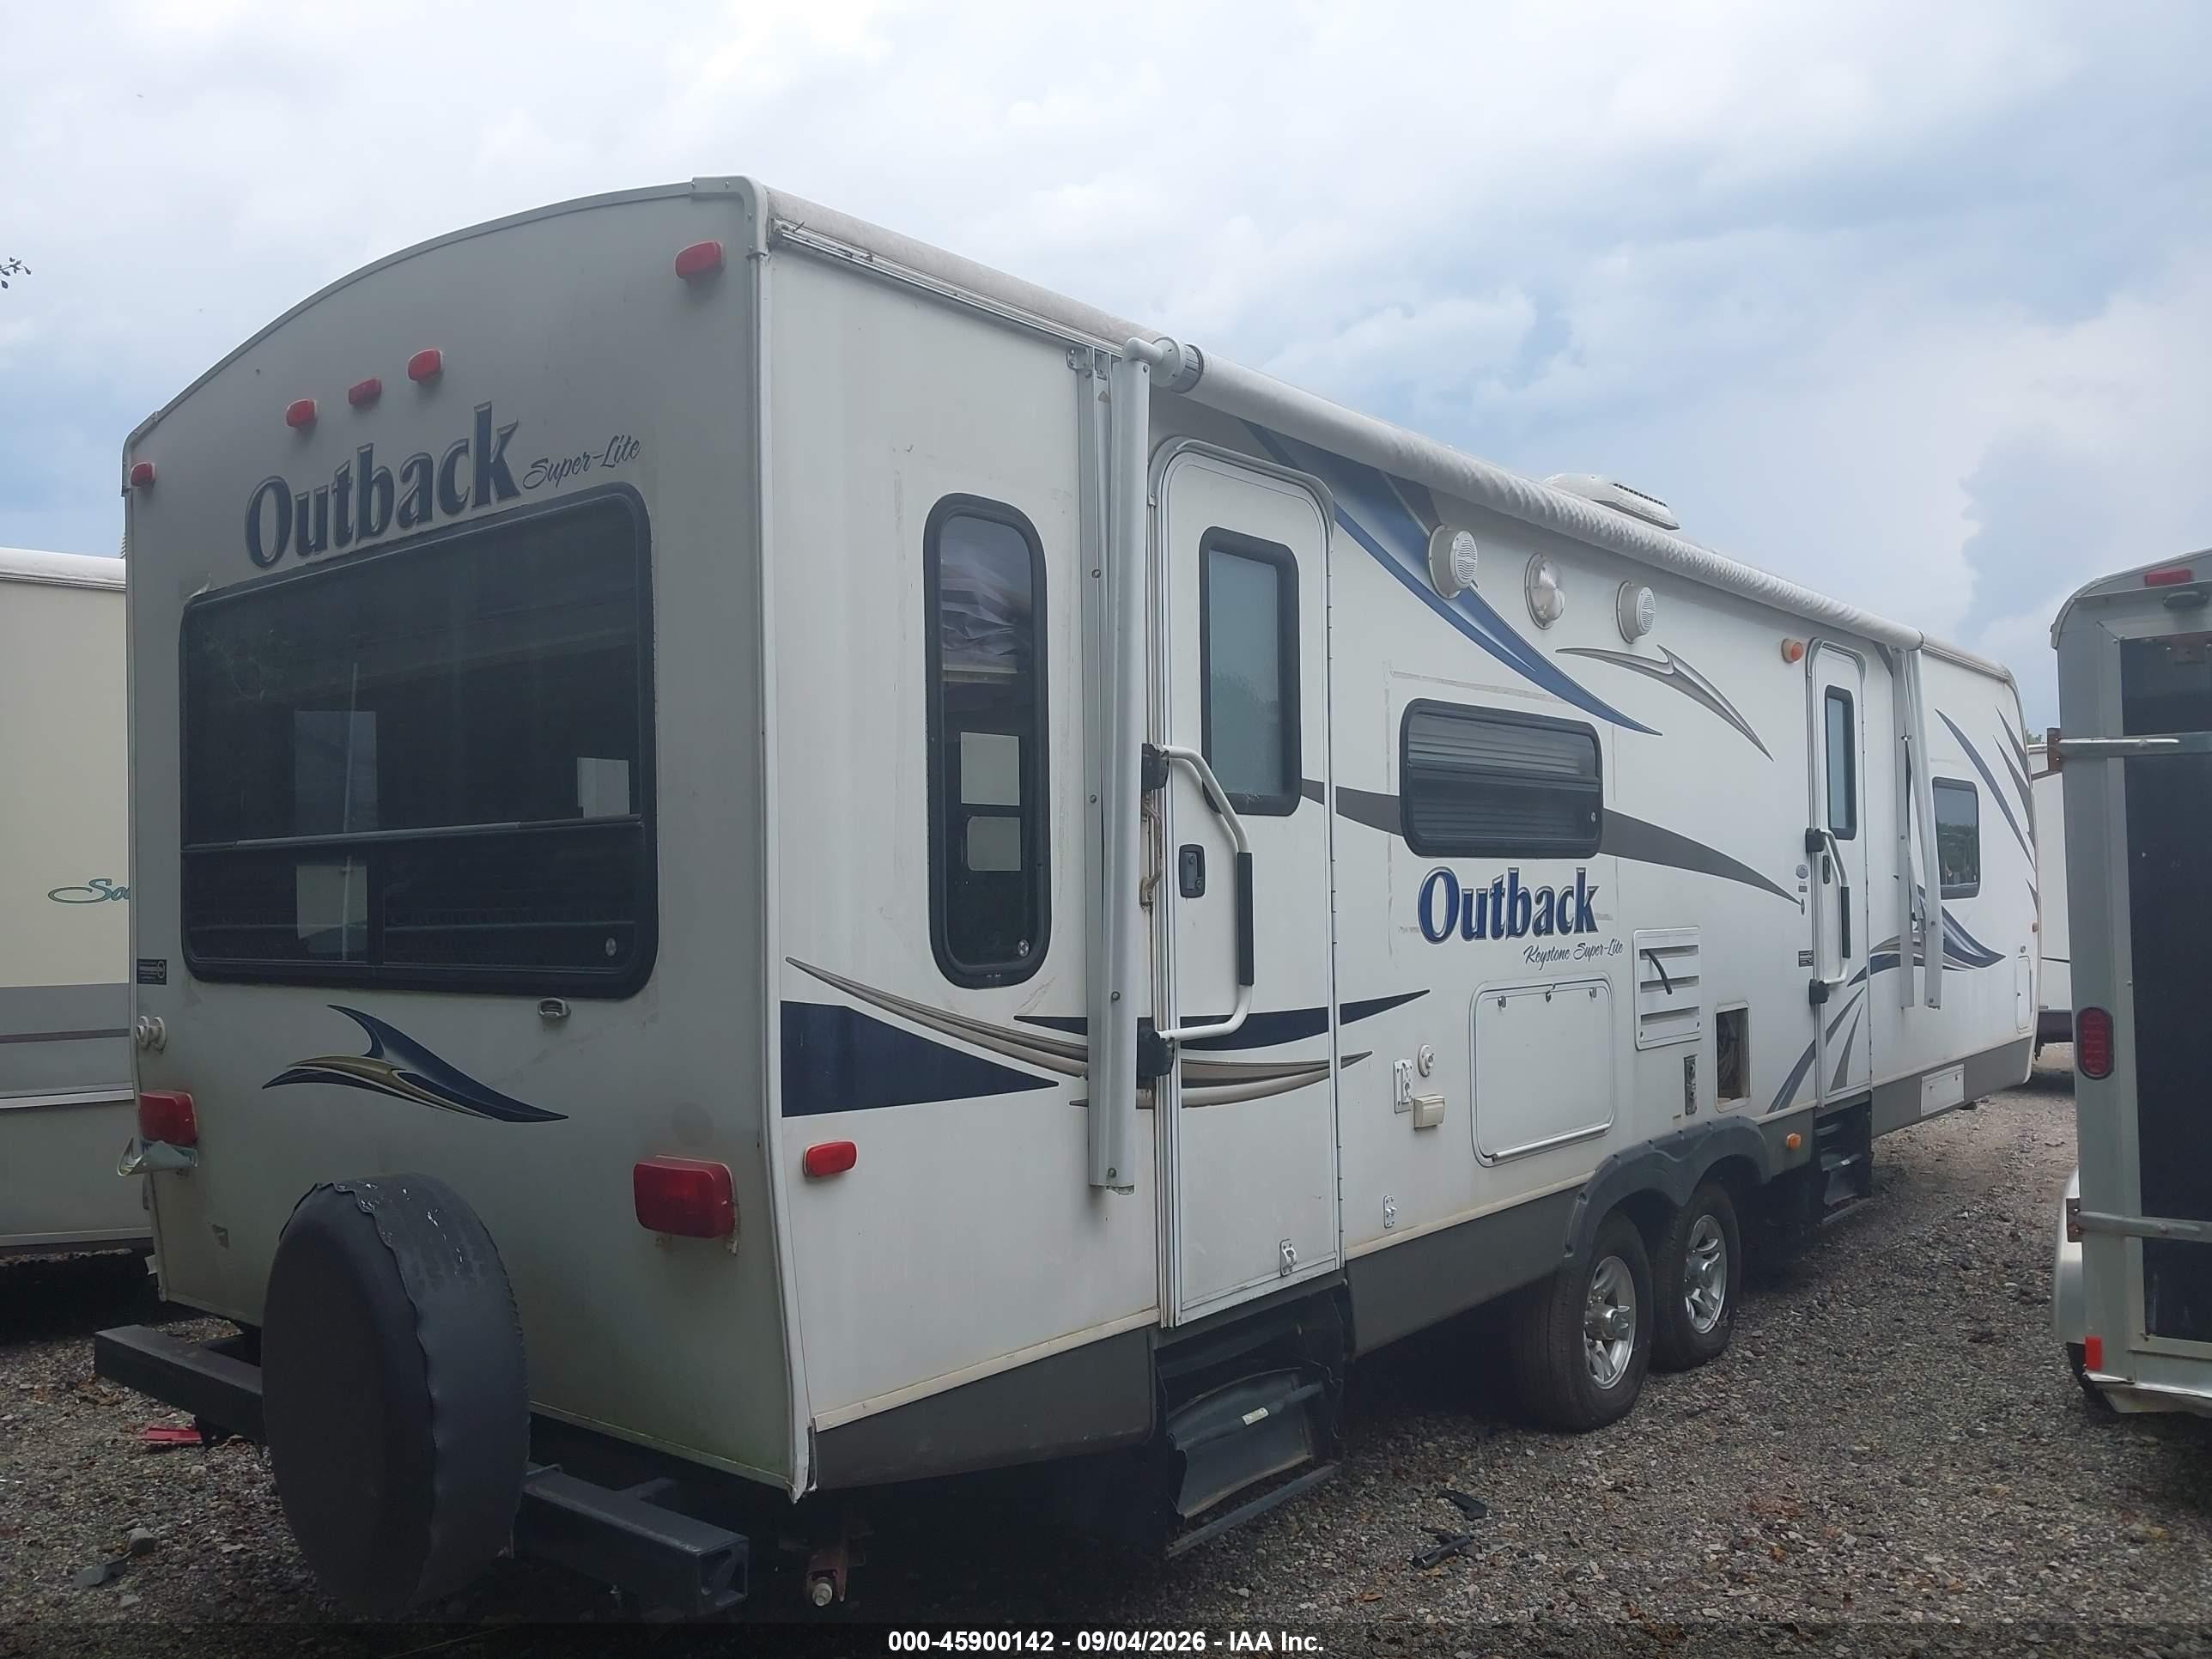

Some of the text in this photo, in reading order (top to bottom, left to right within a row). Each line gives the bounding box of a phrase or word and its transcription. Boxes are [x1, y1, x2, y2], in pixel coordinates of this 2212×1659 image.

[245, 400, 641, 568] Outback Super-Lite
[1418, 866, 1600, 945] Outback
[1522, 938, 1624, 971] Keystone Super-Lite
